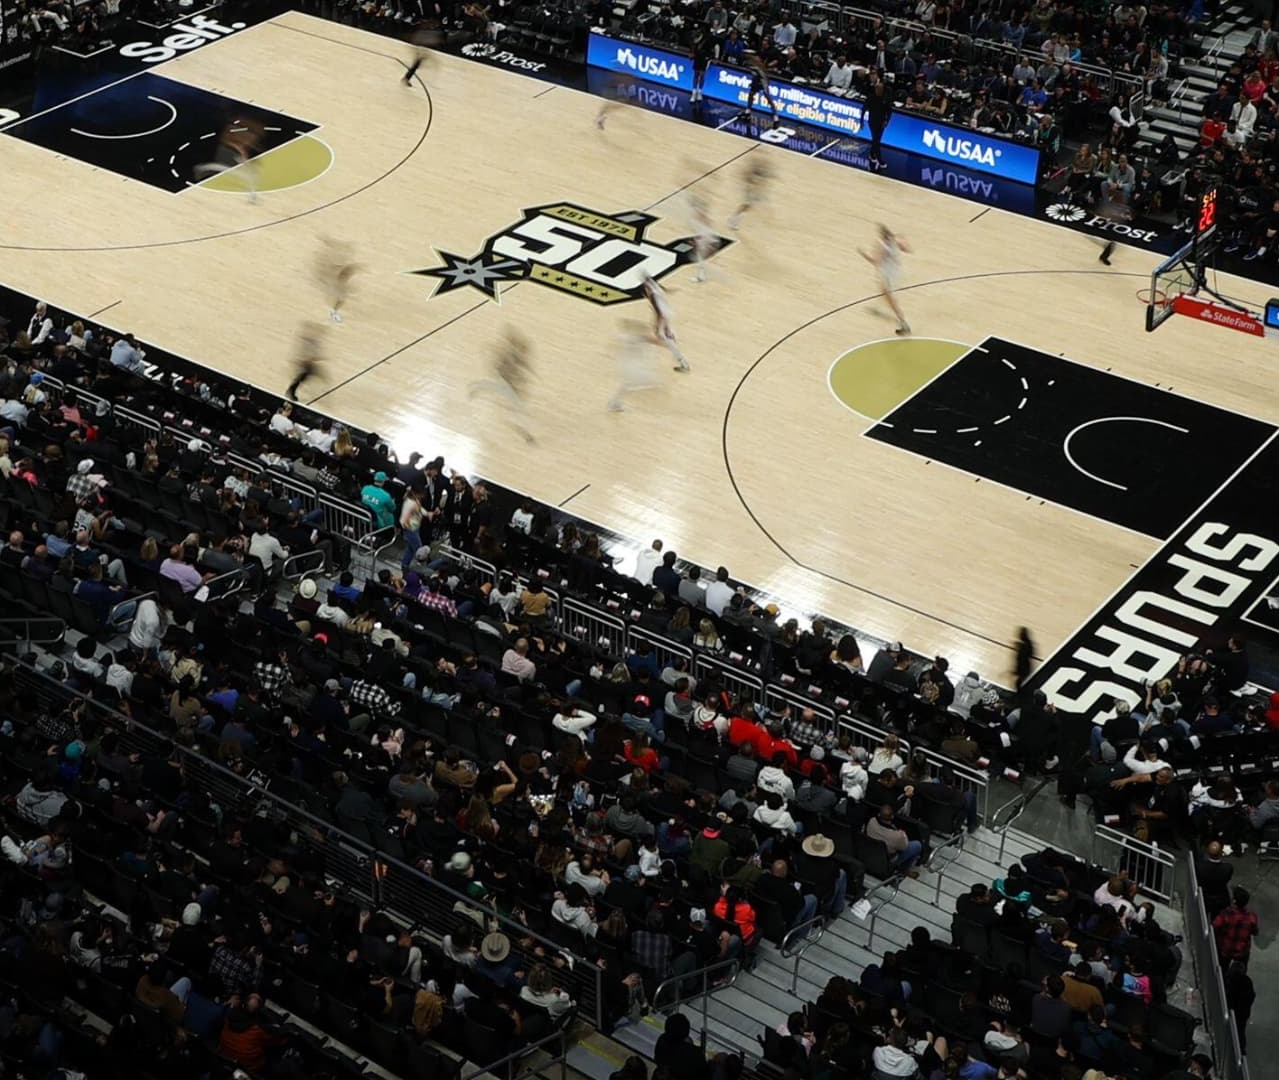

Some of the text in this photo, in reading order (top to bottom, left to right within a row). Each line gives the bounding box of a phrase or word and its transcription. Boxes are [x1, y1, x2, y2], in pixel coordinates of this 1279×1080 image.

[120, 15, 246, 64] Self.
[492, 49, 548, 72] Frost
[638, 56, 679, 80] USAA
[719, 70, 752, 88] Servi
[781, 88, 821, 109] military
[787, 104, 825, 121] eligible
[827, 112, 860, 133] family
[946, 139, 995, 166] USAA
[557, 207, 630, 234] EST 1973
[1085, 215, 1157, 242] Frost
[492, 214, 677, 290] 50
